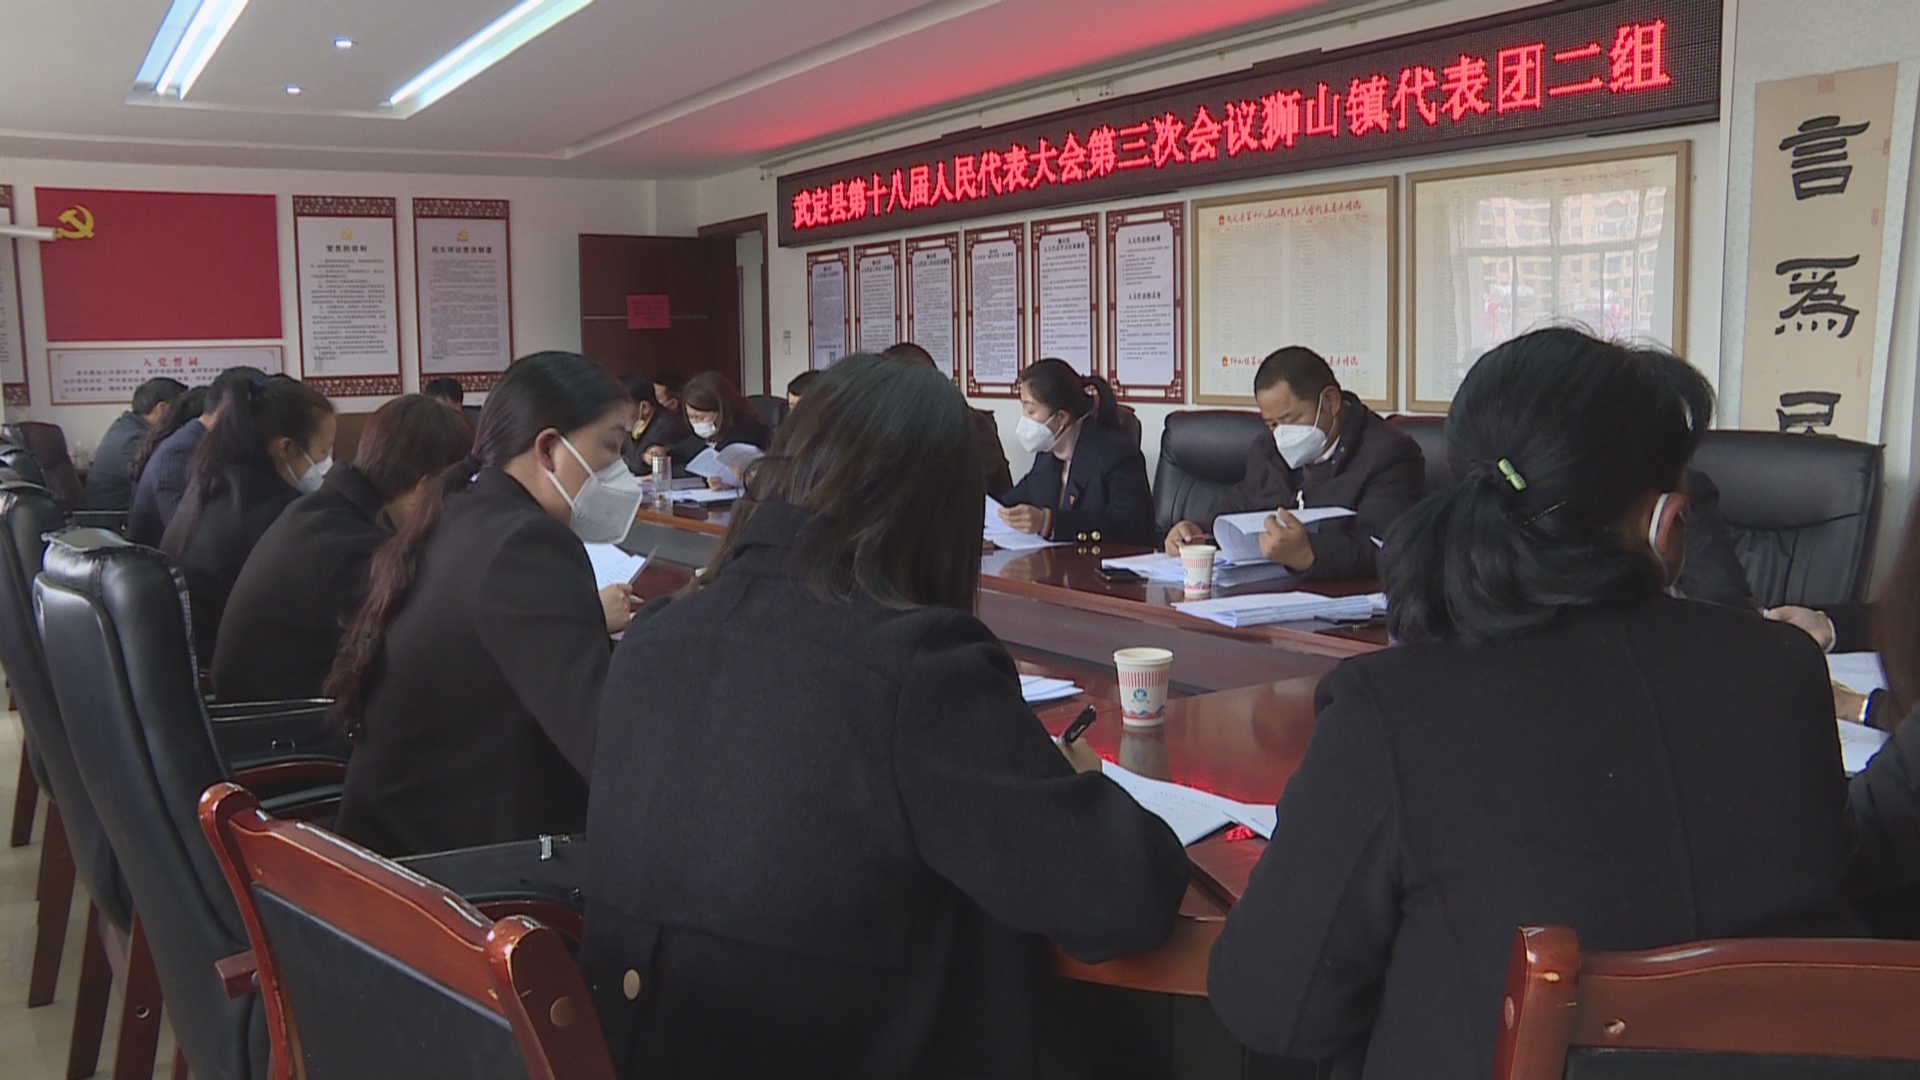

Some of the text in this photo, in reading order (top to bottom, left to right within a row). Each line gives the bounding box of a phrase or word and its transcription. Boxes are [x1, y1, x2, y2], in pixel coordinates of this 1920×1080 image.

[792, 18, 1671, 231] 武定县第十八届人民代表大会第三次会议狮山镇代表团二组
[143, 356, 199, 368] 入党誓词
